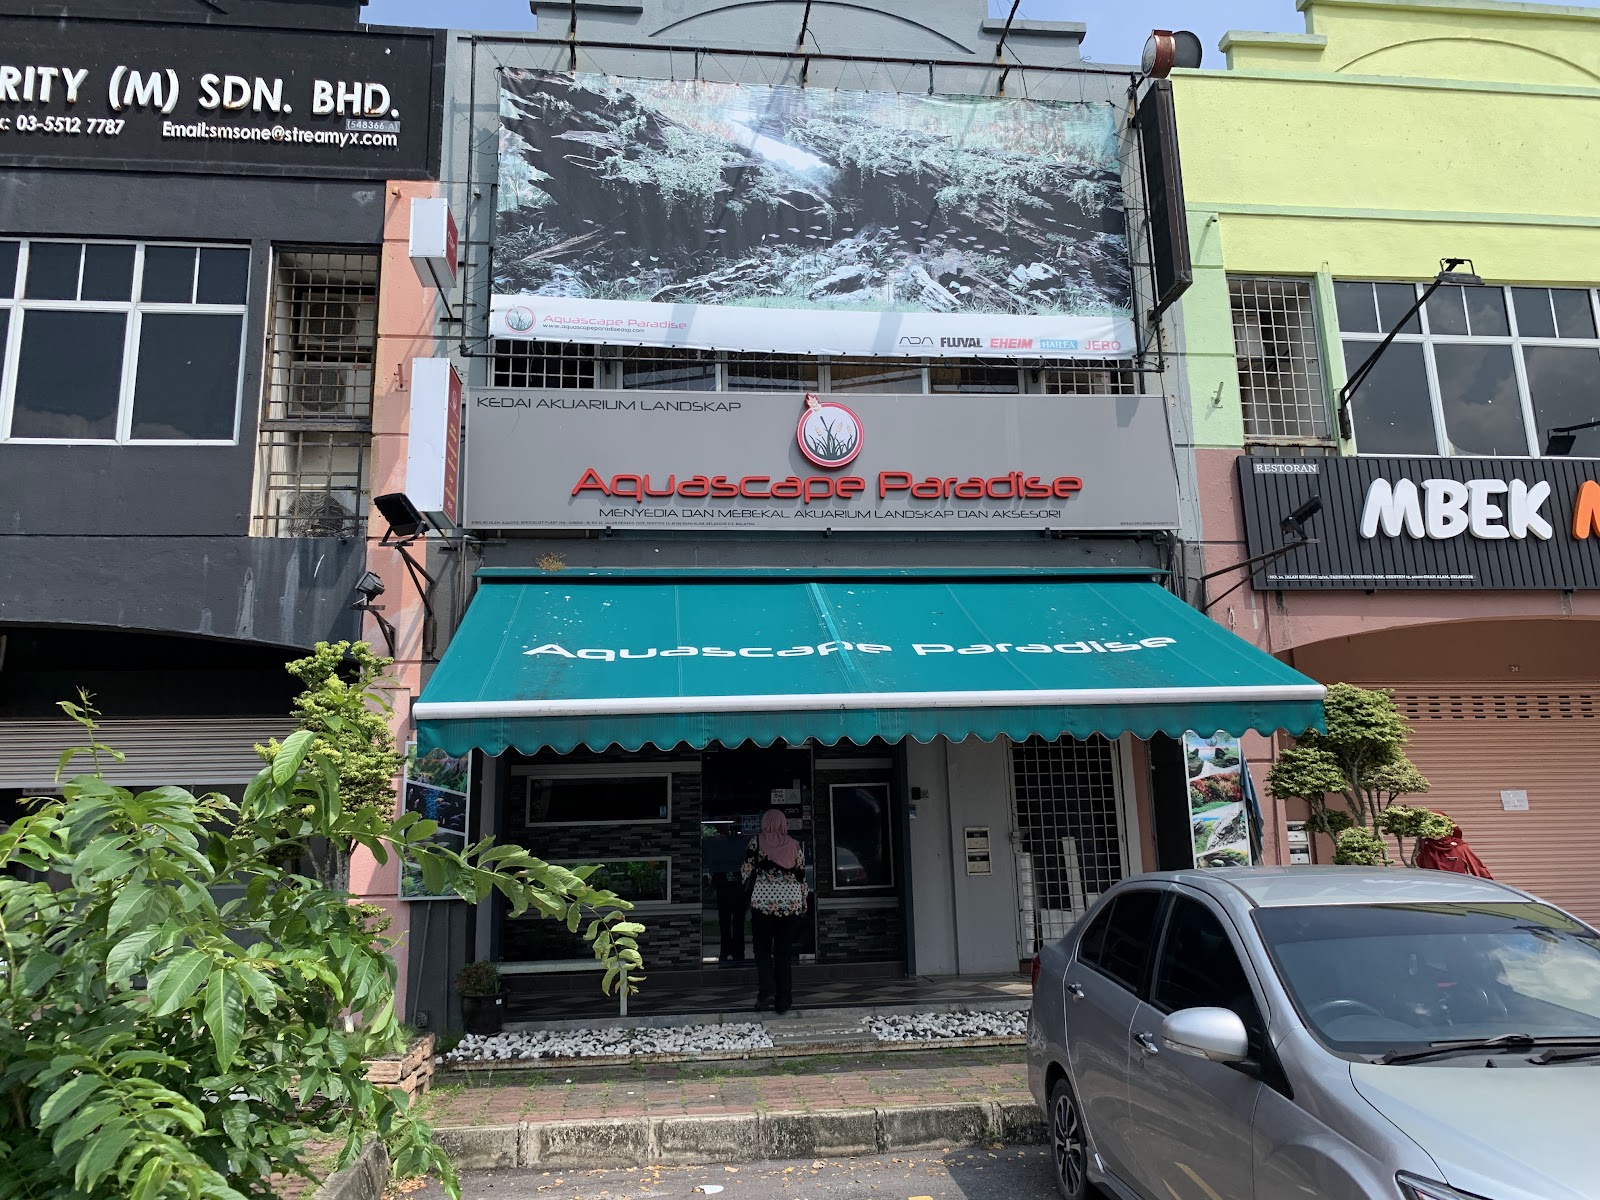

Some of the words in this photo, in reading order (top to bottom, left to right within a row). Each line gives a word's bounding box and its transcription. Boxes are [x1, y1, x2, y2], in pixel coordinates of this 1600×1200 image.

[0, 65, 89, 104] RITY
[109, 65, 180, 114] (M)
[198, 74, 292, 114] SDN.
[312, 80, 400, 118] BHD.
[16, 114, 81, 134] 03-5512
[87, 118, 126, 136] 7787
[163, 120, 398, 147] Email:smsone@streamyx.com
[543, 314, 623, 327] Aquascape
[627, 319, 687, 330] Paradise
[940, 337, 983, 348] FLUVAL
[989, 337, 1033, 349] EHEIM
[1041, 339, 1077, 350] HAILEA
[1084, 340, 1121, 351] JEBO
[476, 397, 532, 409] KEDAI
[535, 398, 638, 411] AKUARIUM
[640, 400, 741, 413] LANDSKAP
[1254, 463, 1317, 473] RESTORAN
[571, 468, 866, 504] Aquascape
[878, 471, 1083, 500] Paradise
[600, 508, 678, 518] MENYEDIA
[682, 509, 715, 518] DAN
[718, 509, 790, 518] MEBEKAL
[794, 509, 871, 519] AKUARIUM
[874, 510, 954, 519] LANDSKAP
[957, 510, 989, 519] DAN
[992, 510, 1061, 519] AKSESORI
[1360, 477, 1553, 540] MBEK
[522, 641, 893, 662] Aquascape
